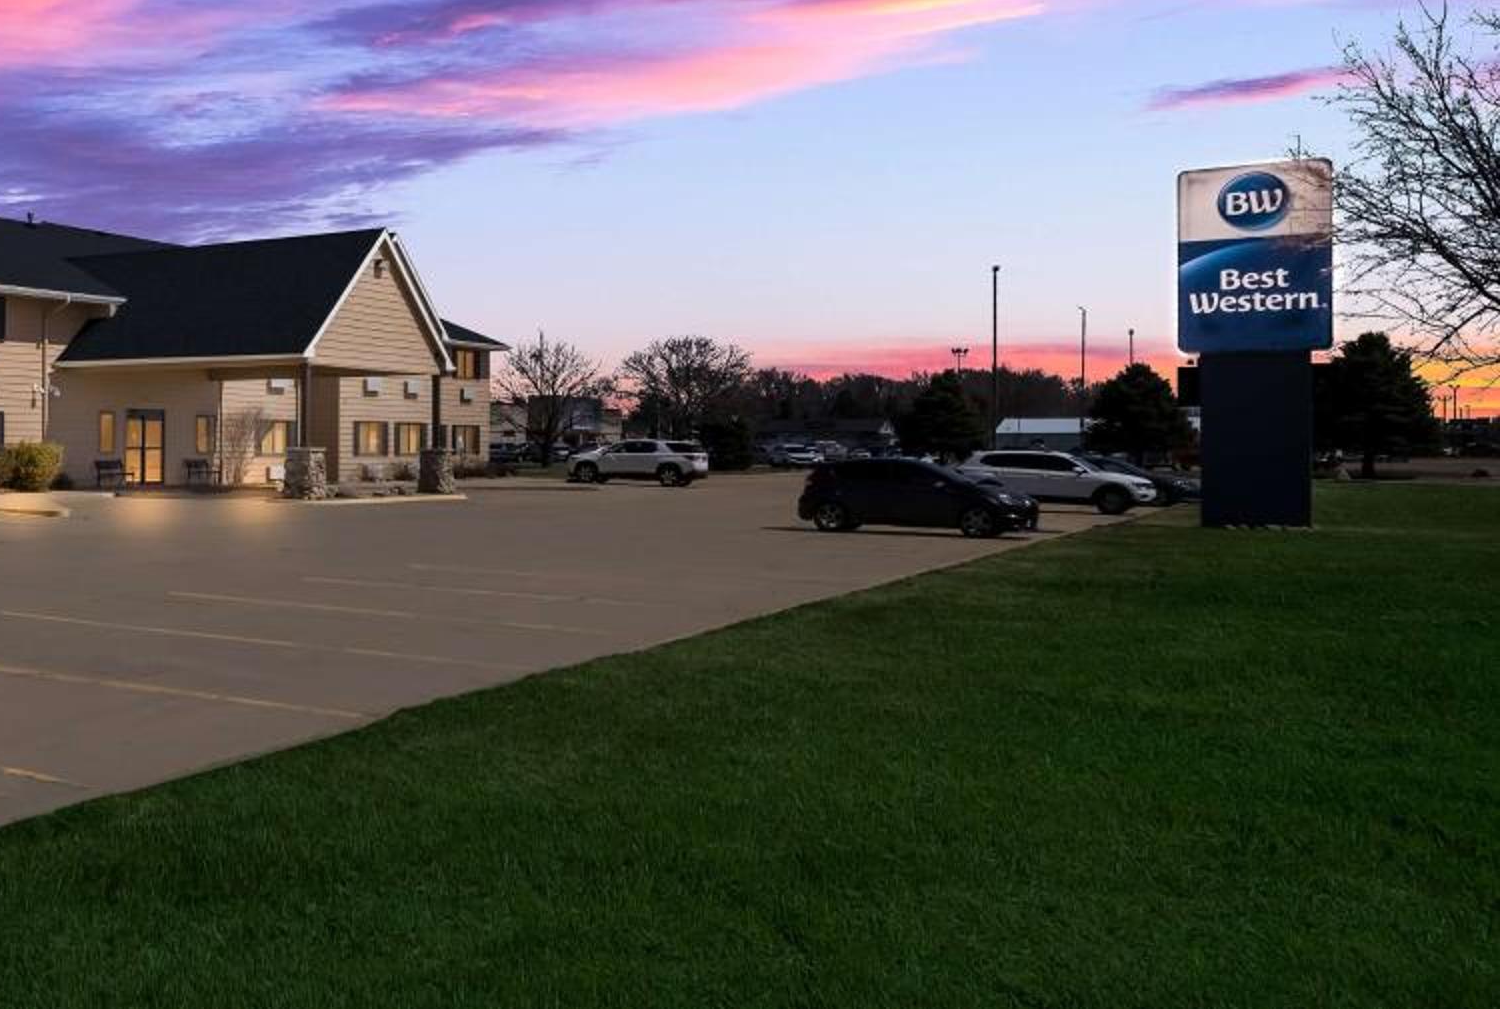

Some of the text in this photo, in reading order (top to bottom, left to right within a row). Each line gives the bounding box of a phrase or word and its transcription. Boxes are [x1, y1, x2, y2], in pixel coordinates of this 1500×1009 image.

[1225, 189, 1283, 216] BW
[1220, 268, 1290, 290] Best
[1189, 291, 1319, 314] Western
